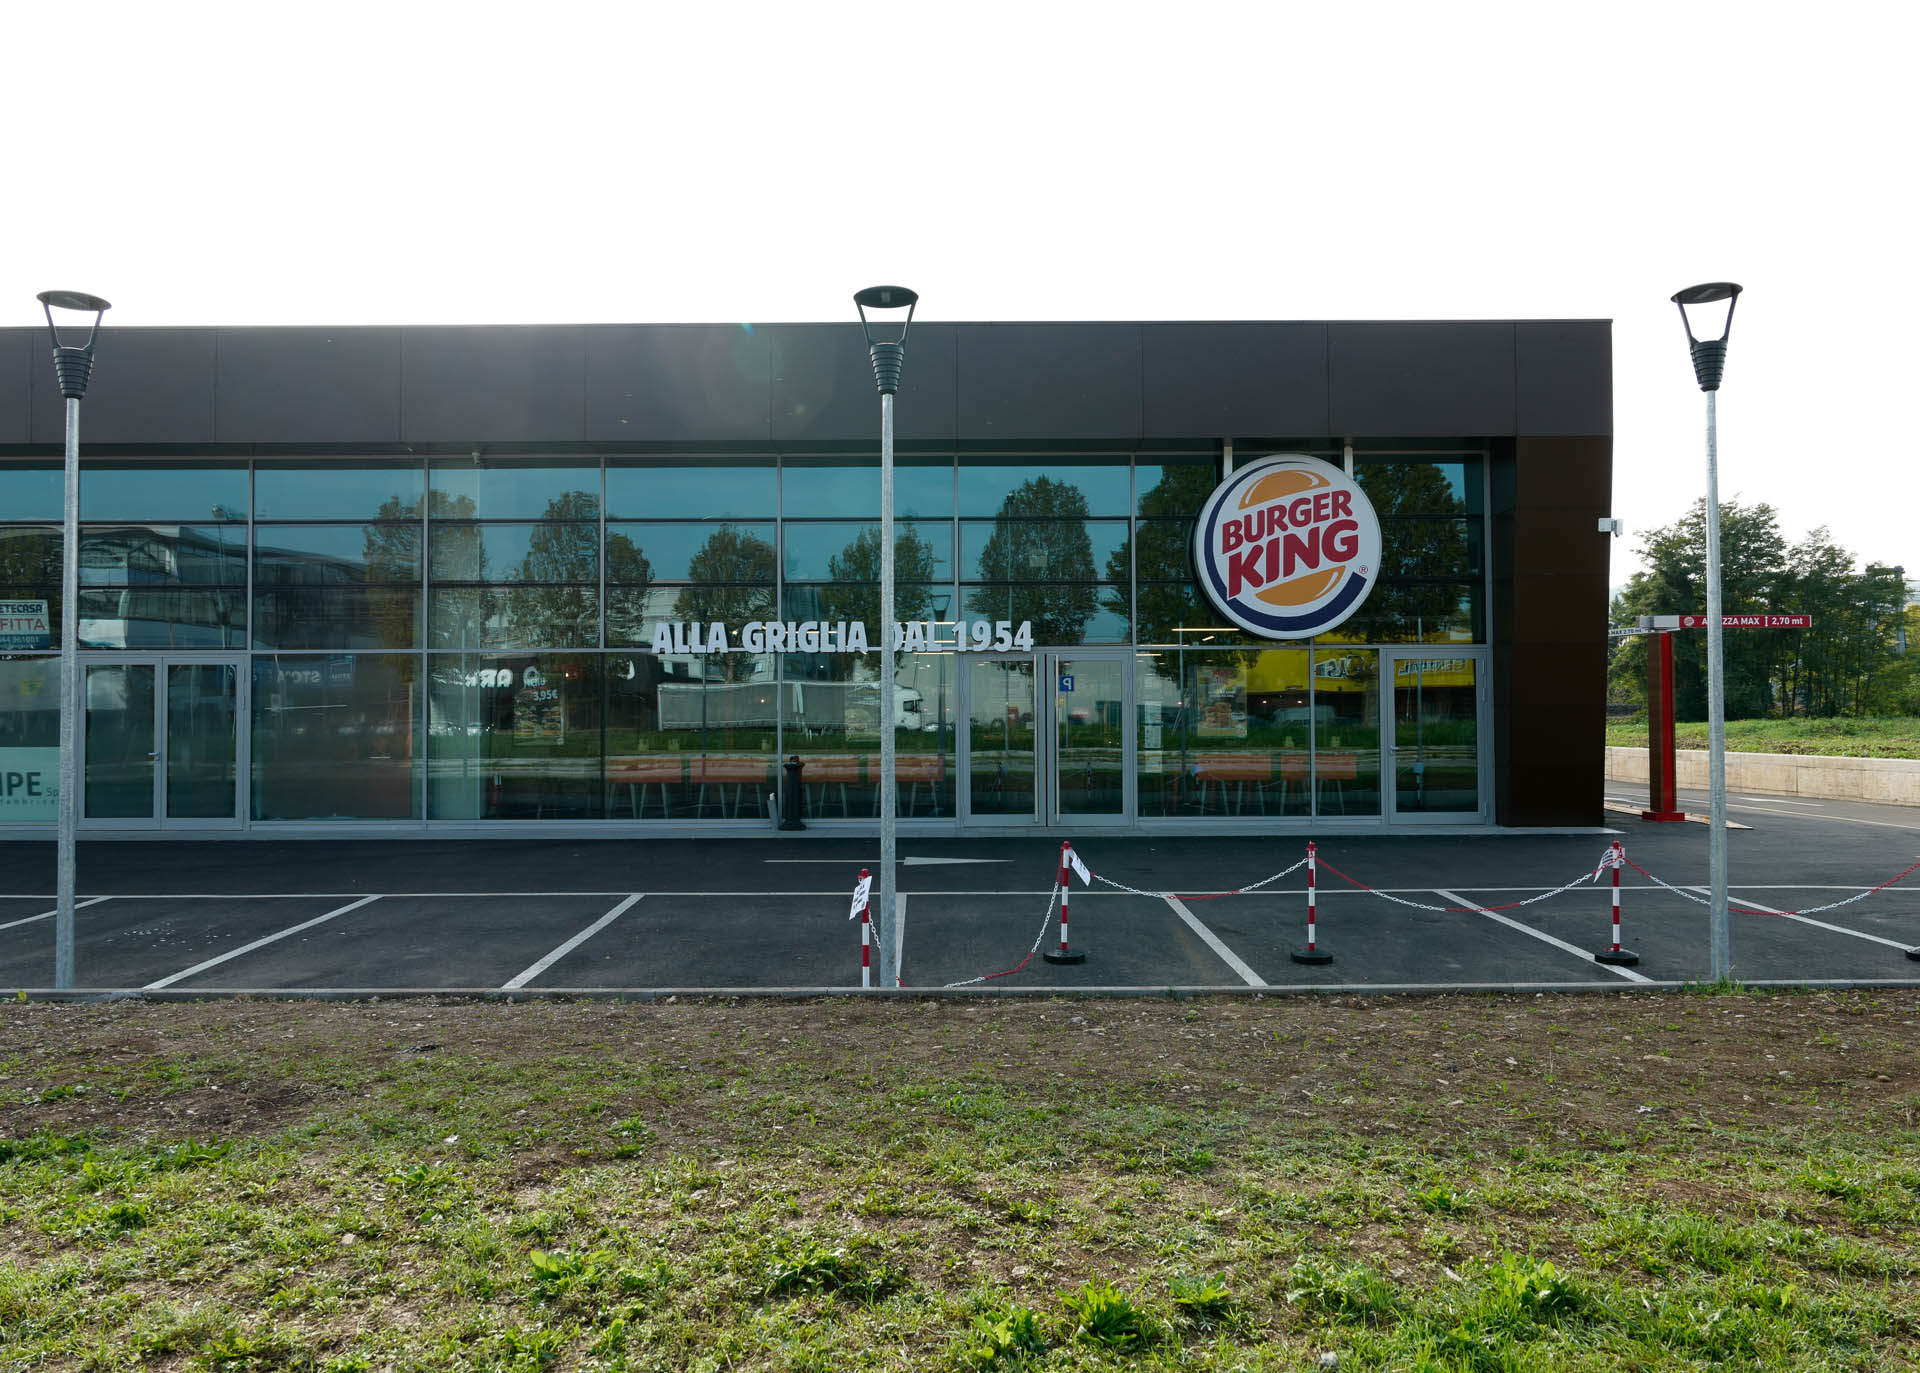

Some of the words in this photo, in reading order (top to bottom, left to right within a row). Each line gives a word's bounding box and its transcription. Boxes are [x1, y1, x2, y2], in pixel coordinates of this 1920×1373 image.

[1222, 490, 1353, 555] BURGER
[1228, 519, 1359, 598] KING
[651, 621, 729, 654] ALLA
[742, 620, 868, 654] GRIGLIA
[952, 620, 1034, 653] 1954
[1702, 617, 1739, 625] AZZA
[1740, 617, 1760, 625] MAX
[1791, 617, 1803, 625] mt
[533, 690, 558, 701] 3,95€
